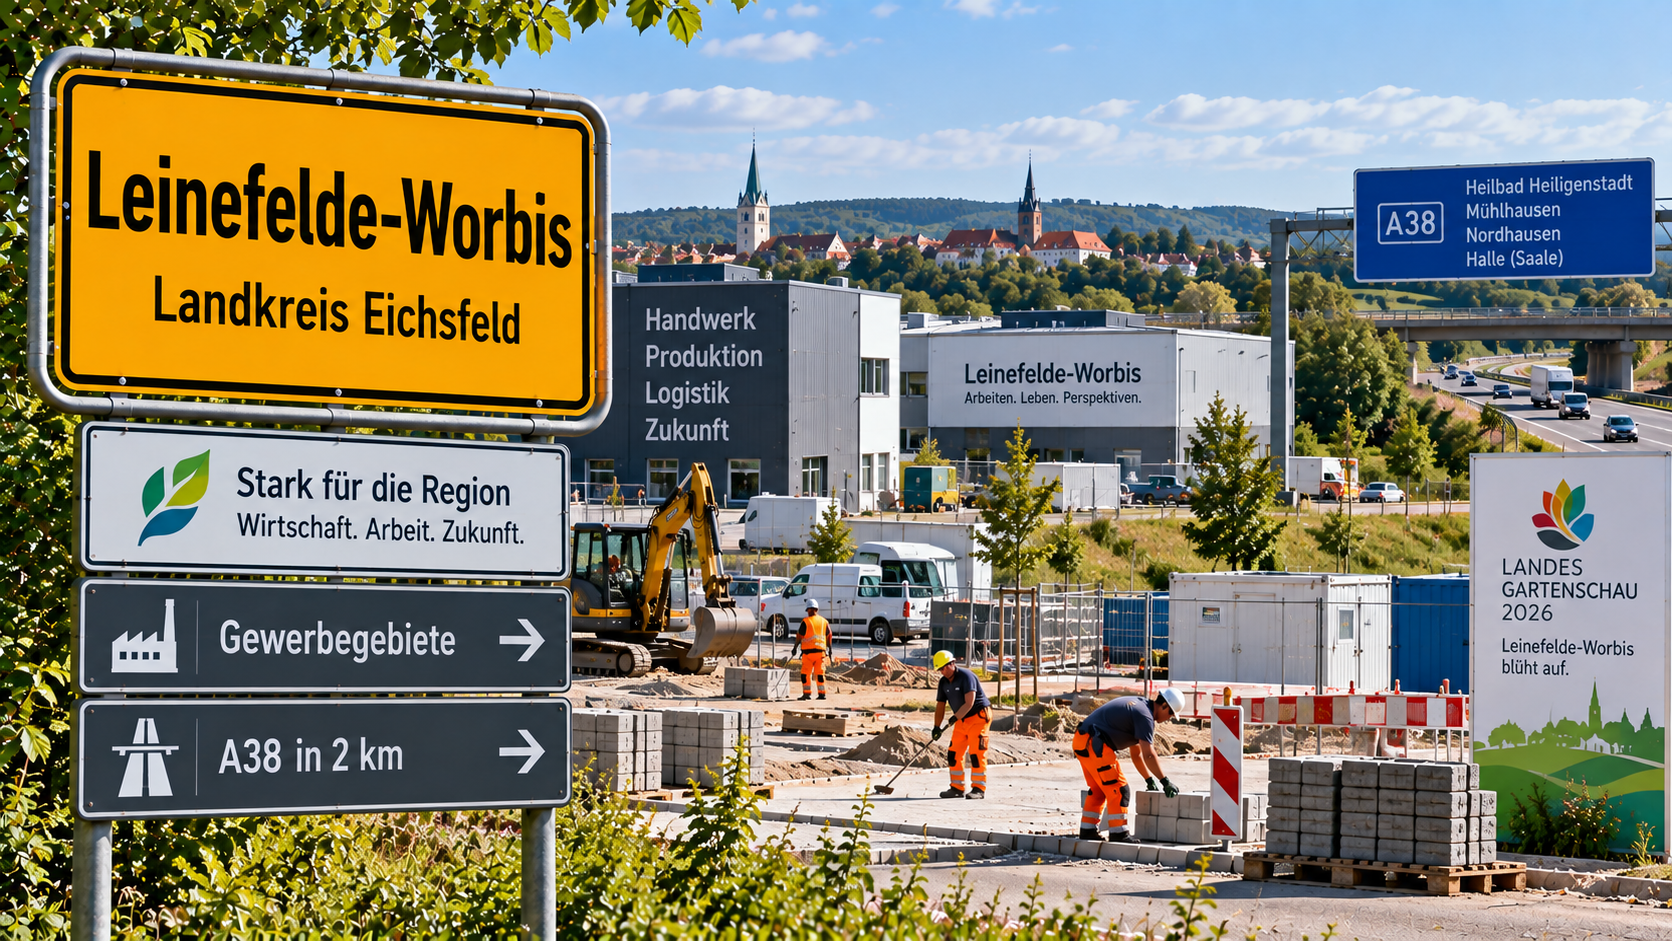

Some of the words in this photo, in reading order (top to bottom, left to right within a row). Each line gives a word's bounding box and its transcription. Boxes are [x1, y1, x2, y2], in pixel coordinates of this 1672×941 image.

[1467, 178, 1523, 195] Heilbad
[1530, 174, 1633, 196] Heiligenstadt
[89, 150, 572, 268] Leinefelde-Worbis
[1467, 202, 1560, 219] Mühlhausen
[1386, 210, 1435, 235] A38
[1467, 226, 1560, 242] Nordhausen
[1467, 251, 1505, 266] Halle
[1511, 249, 1563, 268] (Saale)
[155, 275, 348, 332] Landkreis
[365, 291, 519, 344] Eichsfeld
[646, 306, 756, 330] Handwerk
[646, 344, 762, 367] Produktion
[966, 362, 1141, 384] Leinefelde-Worbis
[646, 381, 729, 409] Logistik
[965, 391, 1017, 404] Arbeiten.
[1021, 391, 1059, 404] Leben.
[1064, 391, 1142, 407] Perspektiven.
[646, 418, 729, 441] Zukunft
[237, 467, 313, 500] Stark
[323, 470, 363, 500] für
[372, 472, 412, 503] die
[423, 475, 509, 513] Region
[237, 513, 357, 539] Wirtschaft.
[366, 518, 434, 541] Arbeit.
[443, 520, 524, 545] Zukunft.
[1503, 558, 1582, 576] LANDES
[1502, 581, 1637, 599] GARTENSCHAU
[1503, 604, 1552, 621] 2026
[220, 619, 455, 663] Gewerbegebiete
[1503, 638, 1634, 656] Leinefelde-Worbis
[1503, 659, 1538, 674] blüht
[1543, 660, 1568, 675] auf.
[219, 738, 281, 773] A38
[297, 738, 320, 772] in
[333, 738, 348, 771] 2
[361, 737, 402, 770] km
